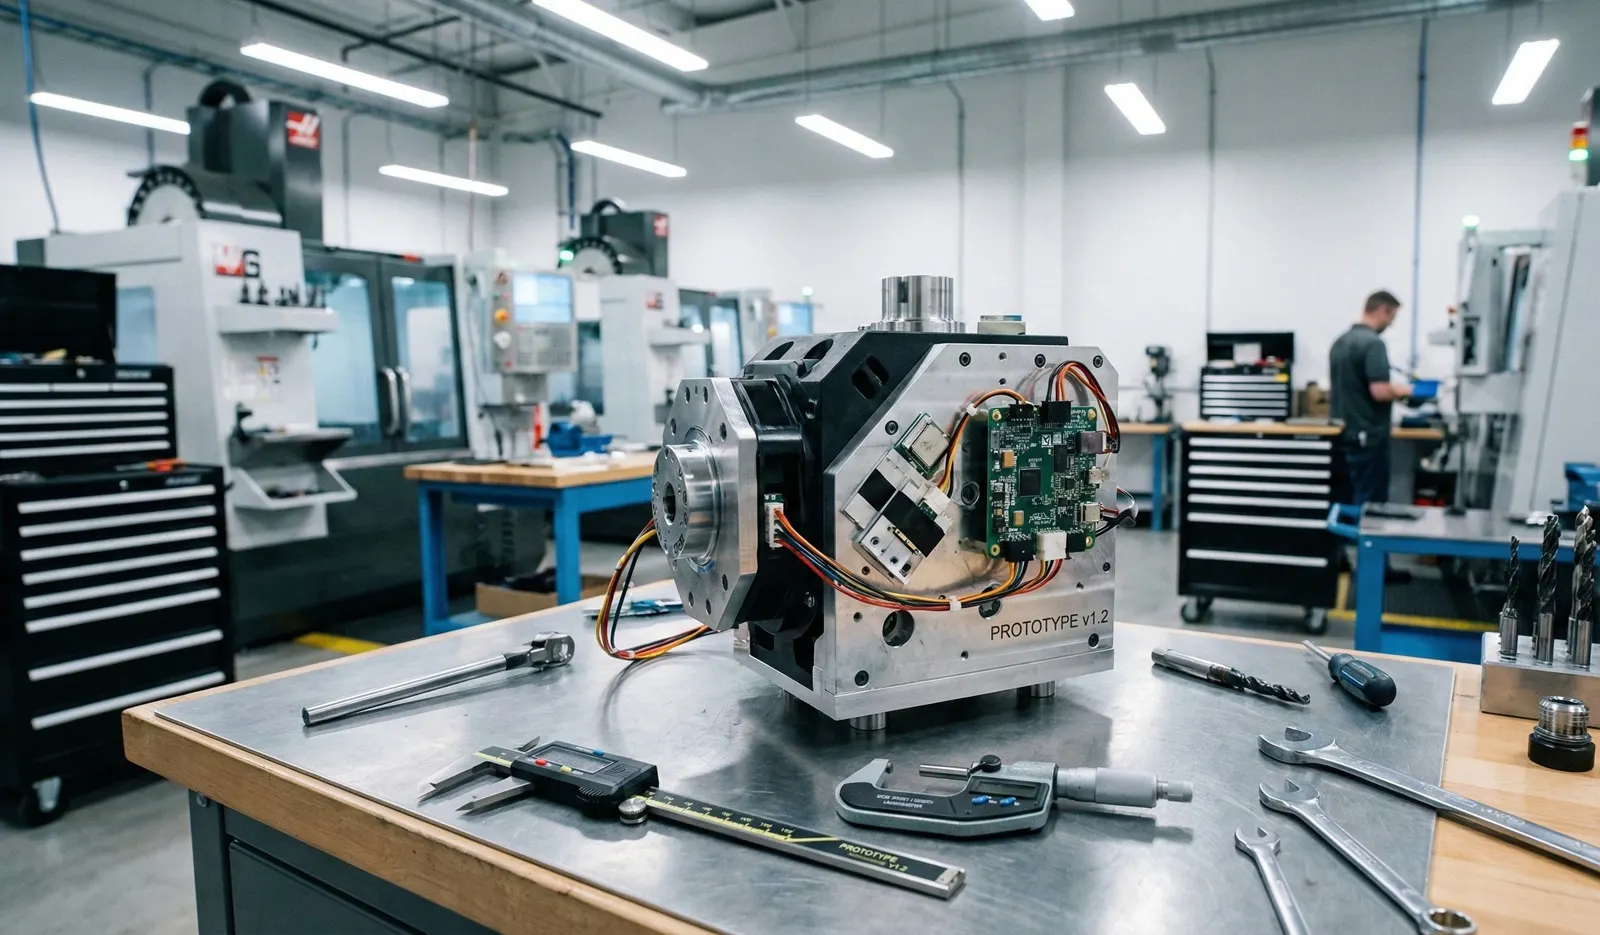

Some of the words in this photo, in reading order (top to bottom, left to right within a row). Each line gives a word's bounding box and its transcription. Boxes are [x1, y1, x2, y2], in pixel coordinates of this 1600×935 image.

[991, 614, 1079, 640] PROTOTYPE
[1083, 610, 1108, 626] v1.2
[839, 843, 899, 863] PROTOTYPE
